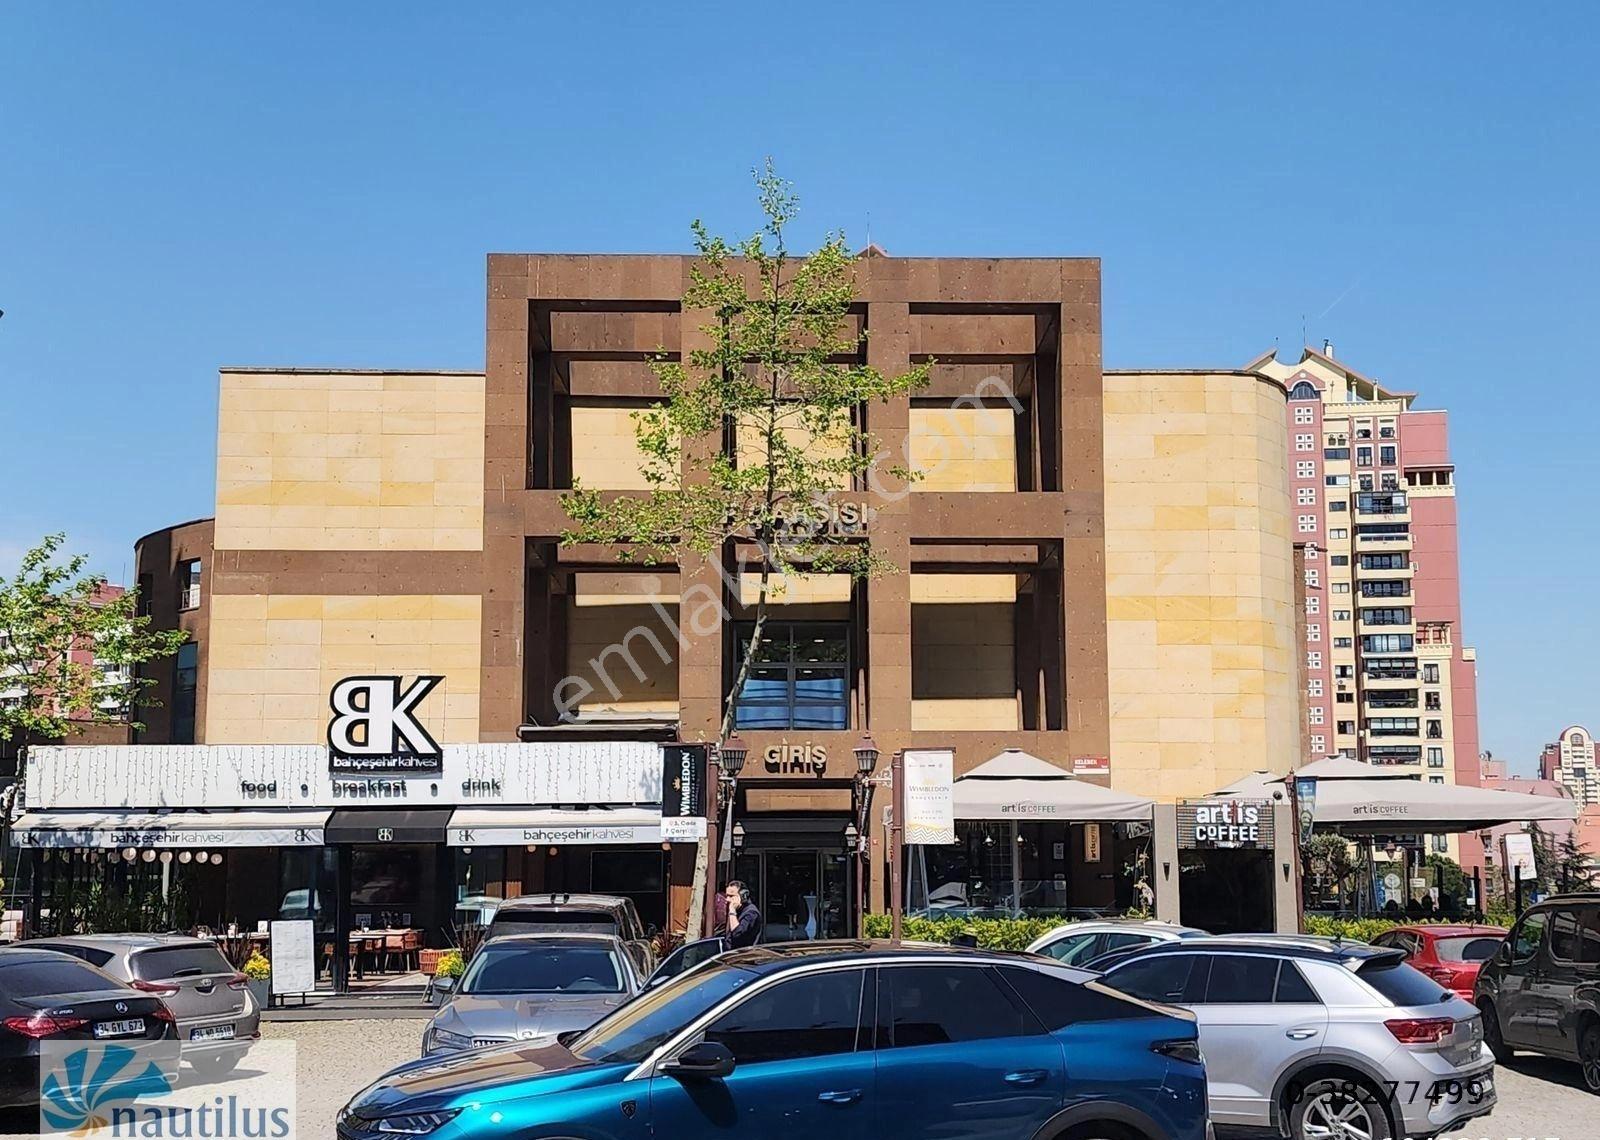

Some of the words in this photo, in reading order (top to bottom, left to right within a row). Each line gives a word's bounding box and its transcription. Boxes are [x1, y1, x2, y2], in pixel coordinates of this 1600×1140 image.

[328, 676, 443, 755] BK
[240, 780, 277, 793] food
[332, 779, 407, 793] breakfast
[461, 778, 501, 791] drink
[680, 752, 691, 816] WIMBLEDON
[1027, 805, 1056, 813] COFFEE
[1380, 805, 1408, 814] COFFEE
[1196, 826, 1259, 841] COFFEE
[98, 1023, 109, 1035] 34
[128, 1020, 143, 1031] 673
